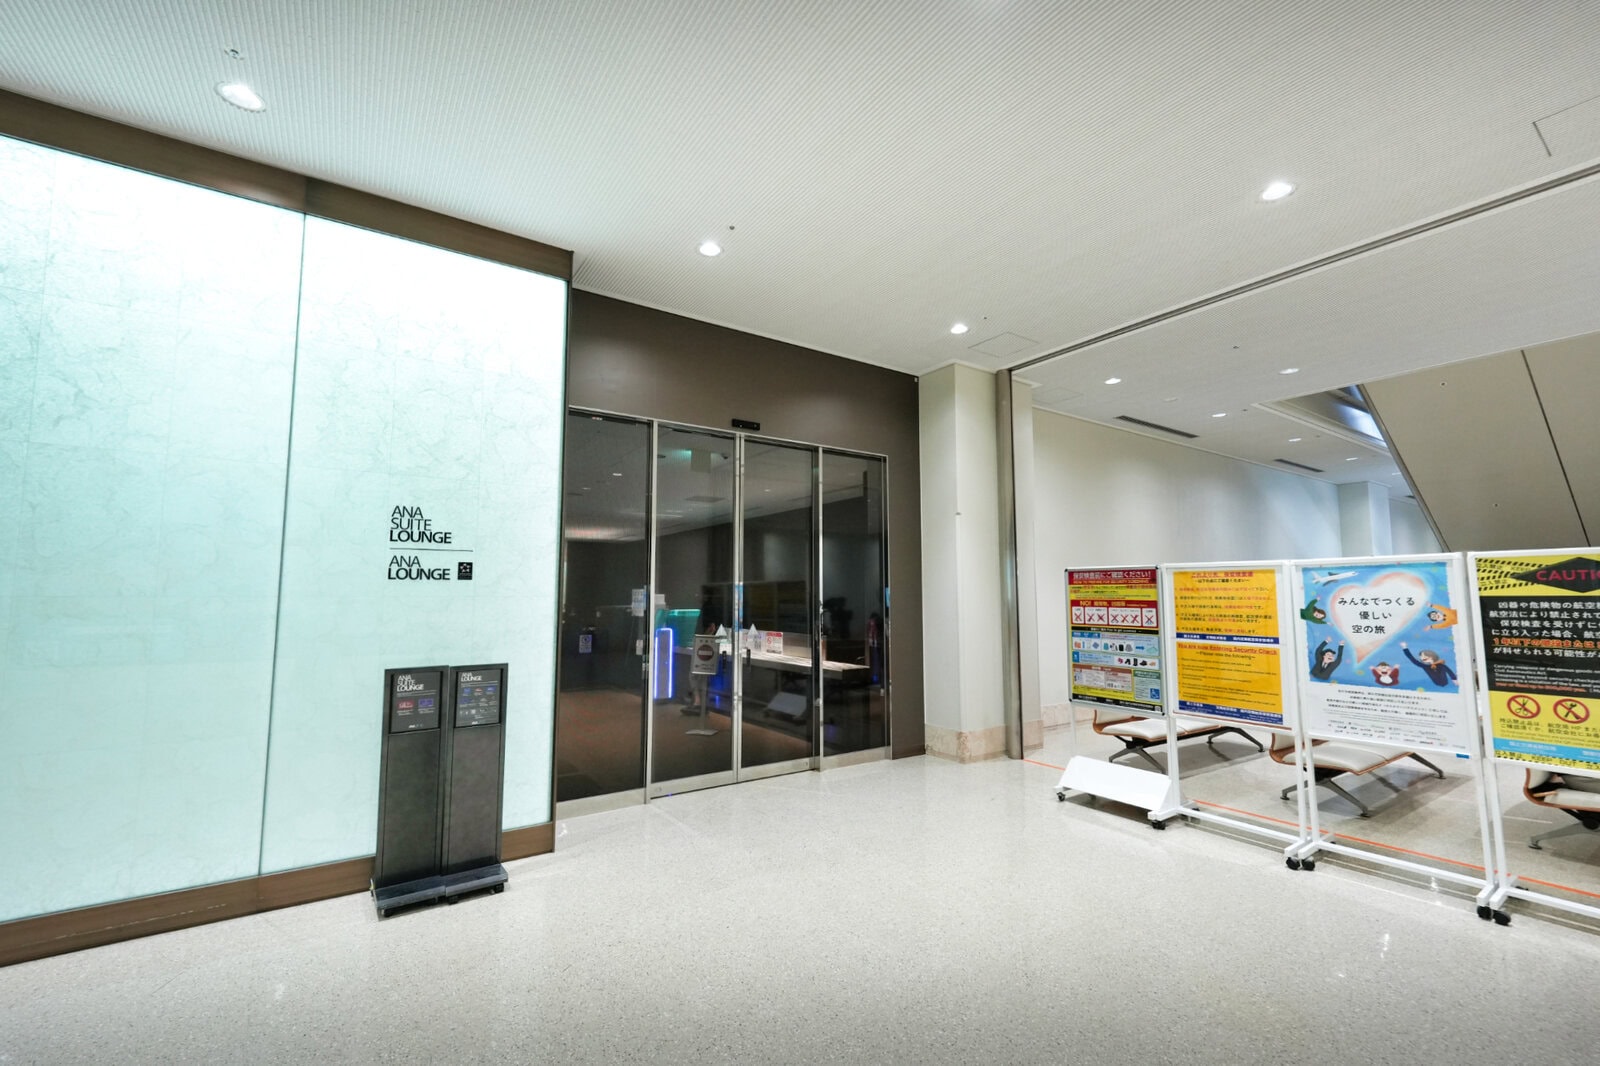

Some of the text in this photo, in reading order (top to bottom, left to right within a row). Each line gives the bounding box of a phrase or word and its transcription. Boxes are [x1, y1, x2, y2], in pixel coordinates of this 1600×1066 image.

[392, 505, 424, 518] ANA
[391, 518, 432, 531] SUITE
[390, 530, 452, 544] LOUNGE
[389, 555, 421, 568] ANA
[388, 568, 450, 580] LOUNGE
[1536, 569, 1600, 581] CAUTI
[1338, 597, 1415, 606] みんなでつくる
[1359, 611, 1392, 620] 優しい
[1352, 625, 1385, 634] 空の旅
[1500, 620, 1600, 629] 保安検査を受けずに
[1493, 647, 1600, 658] が科せられる可能性が
